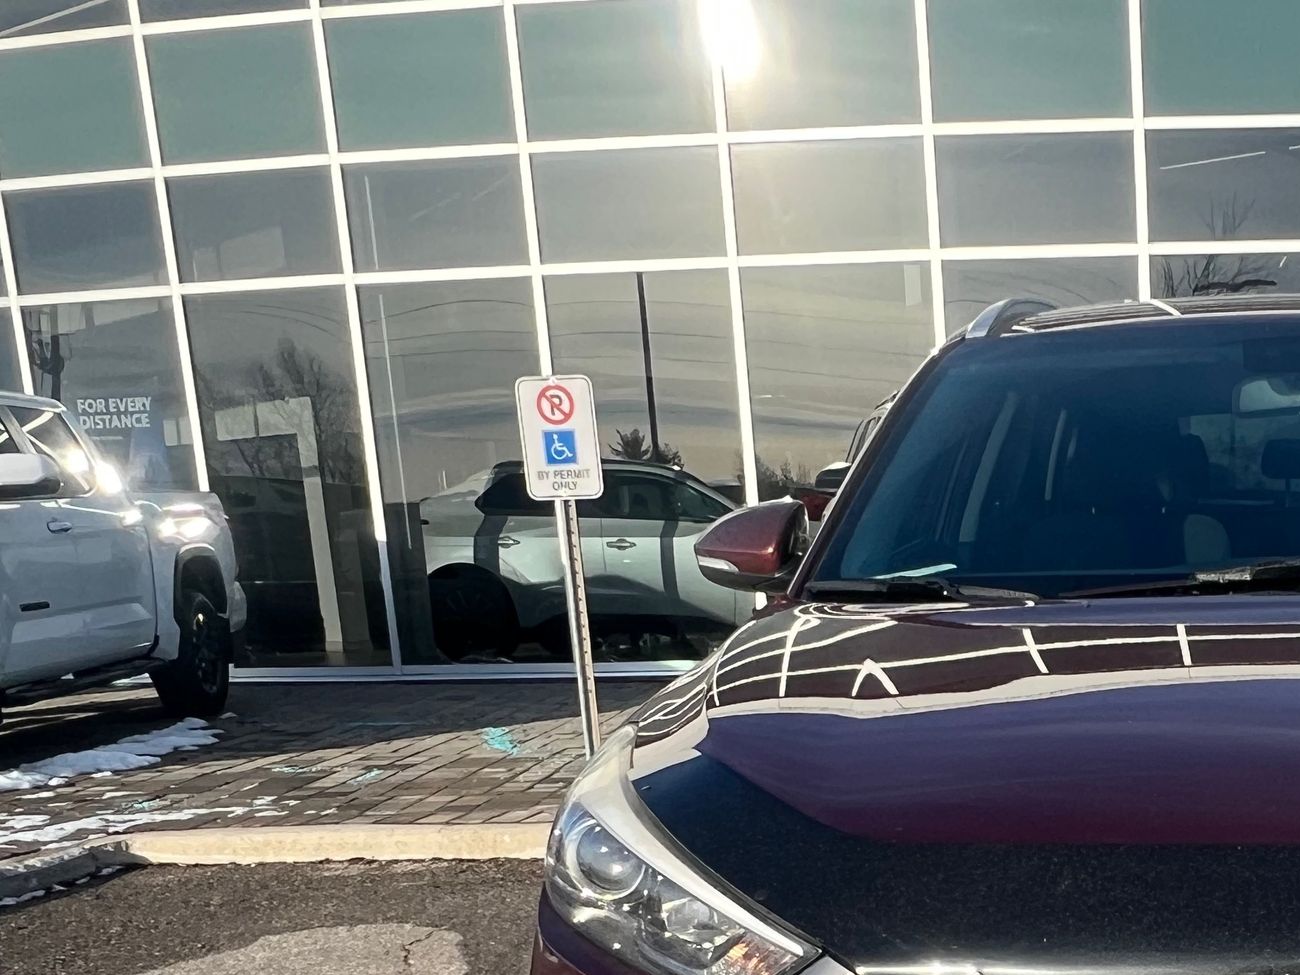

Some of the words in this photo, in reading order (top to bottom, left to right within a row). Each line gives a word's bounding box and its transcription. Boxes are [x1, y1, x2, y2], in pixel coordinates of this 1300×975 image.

[76, 398, 106, 413] FOR
[108, 396, 152, 412] EVERY
[79, 413, 151, 430] DISTANCE
[537, 470, 550, 480] BY
[553, 468, 591, 479] PERMIT
[552, 481, 578, 491] ONLY
